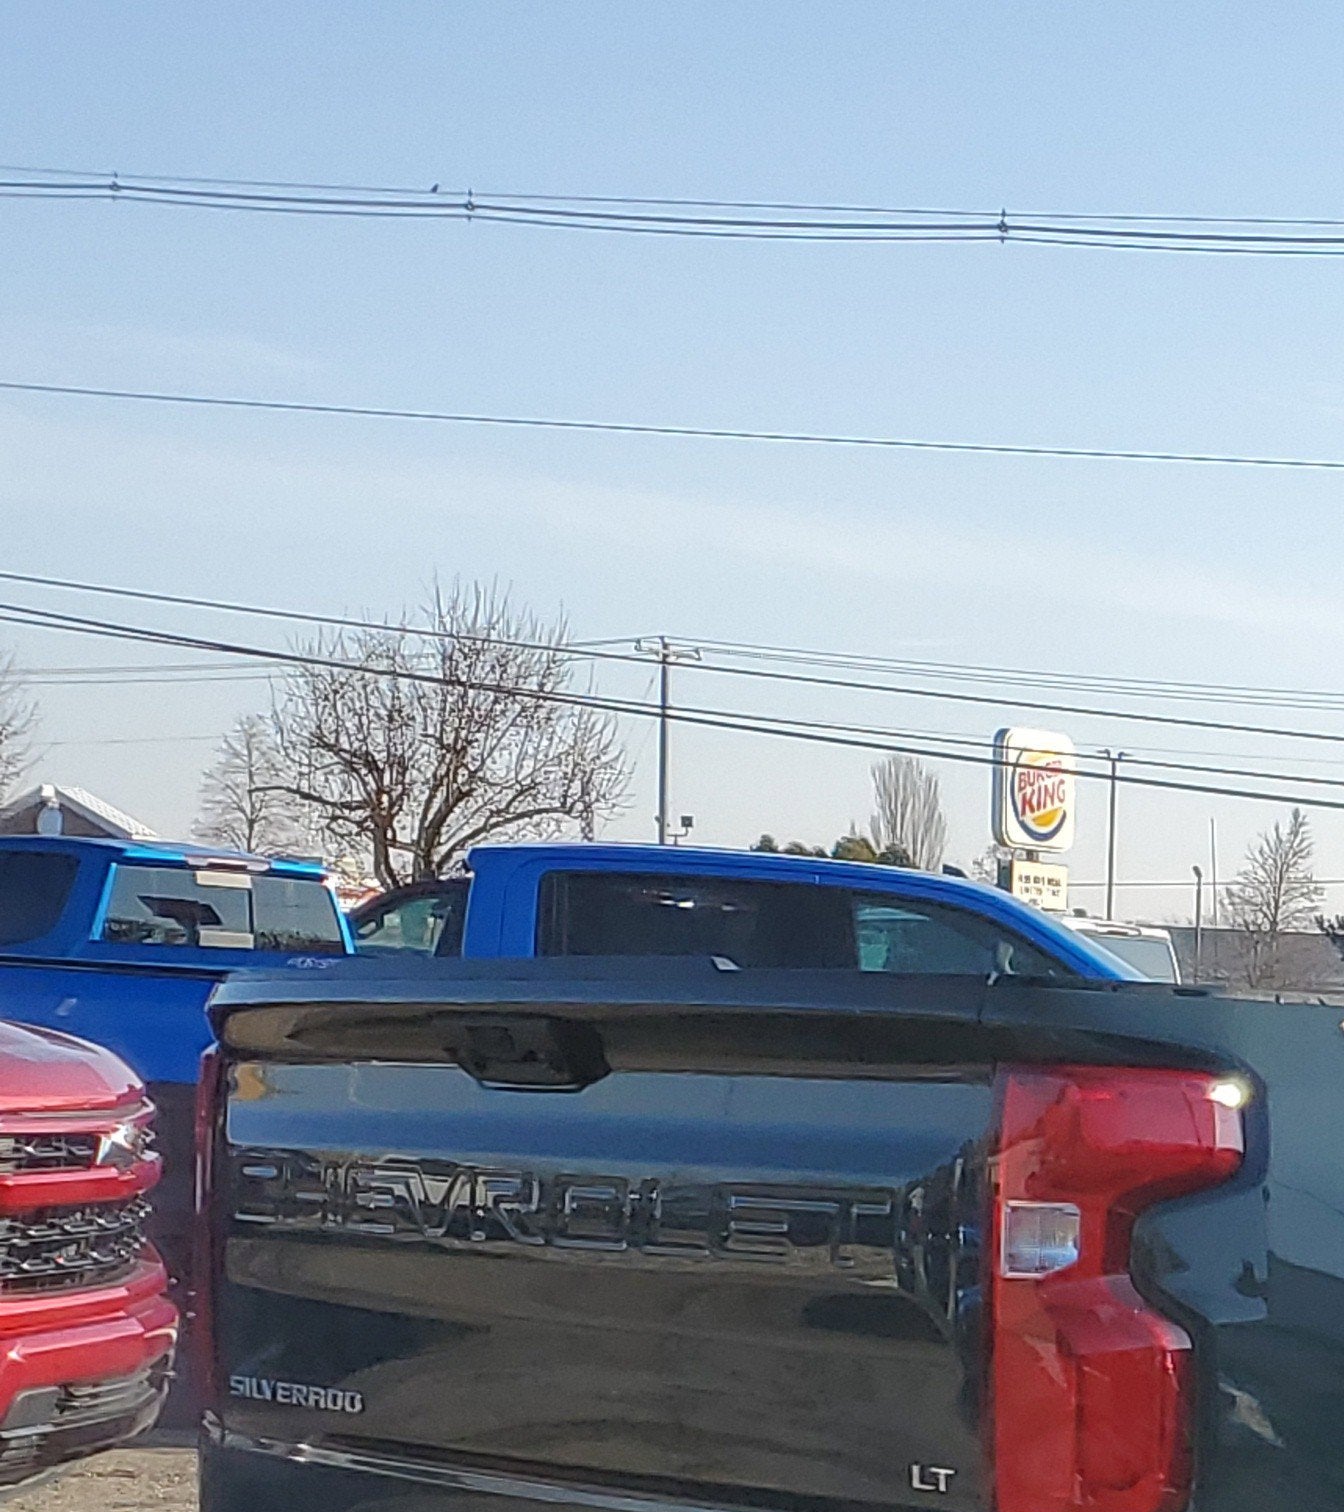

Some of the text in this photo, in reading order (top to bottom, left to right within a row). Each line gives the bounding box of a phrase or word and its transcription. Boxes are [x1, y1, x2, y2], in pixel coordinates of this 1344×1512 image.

[1021, 778, 1065, 817] KING
[229, 1375, 364, 1413] SILVERADO
[911, 1464, 956, 1492] LT
